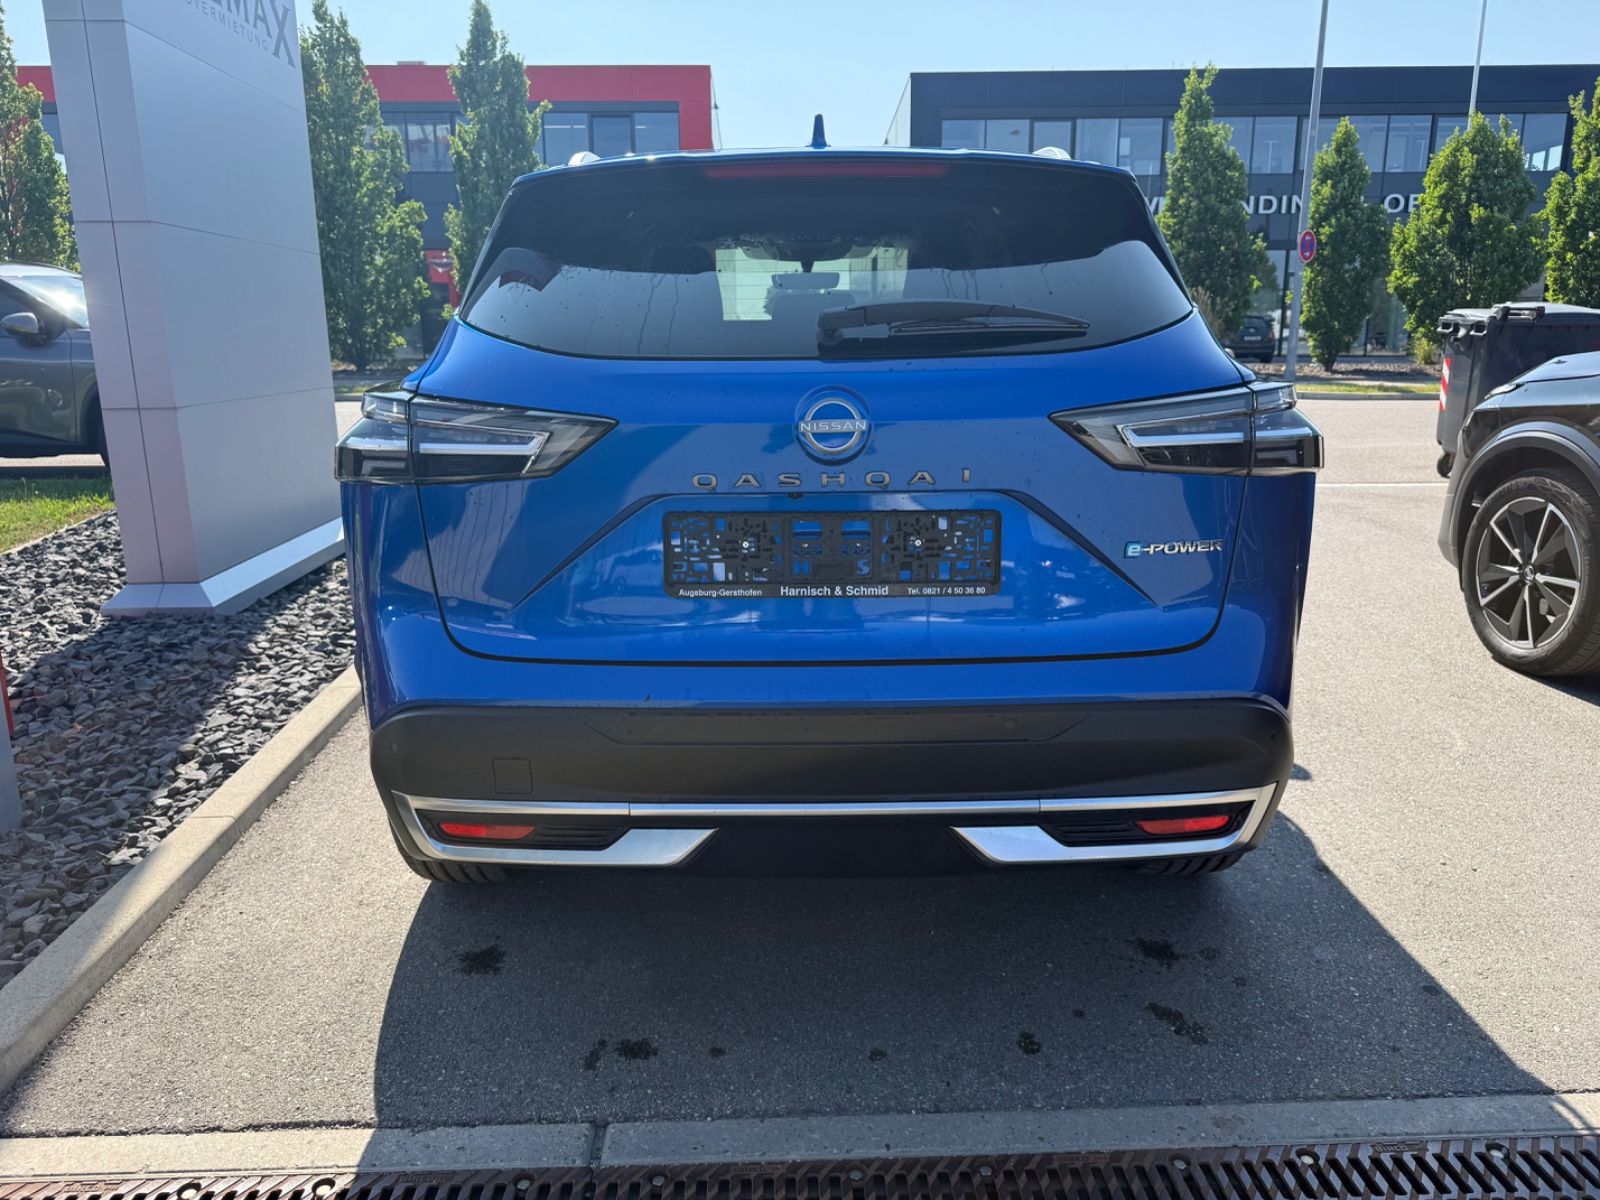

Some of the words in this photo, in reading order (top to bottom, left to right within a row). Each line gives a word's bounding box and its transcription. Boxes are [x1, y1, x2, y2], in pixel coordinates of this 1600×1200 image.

[800, 421, 867, 432] NISSAN
[691, 468, 970, 491] QASHQAI
[1124, 540, 1223, 557] e-POWER
[678, 588, 763, 598] Augsburg-Gersthofen
[780, 585, 831, 596] Harnisch
[834, 585, 843, 596] &
[845, 585, 889, 596] Schmid
[907, 587, 921, 595] Tel.
[922, 587, 940, 595] 0821
